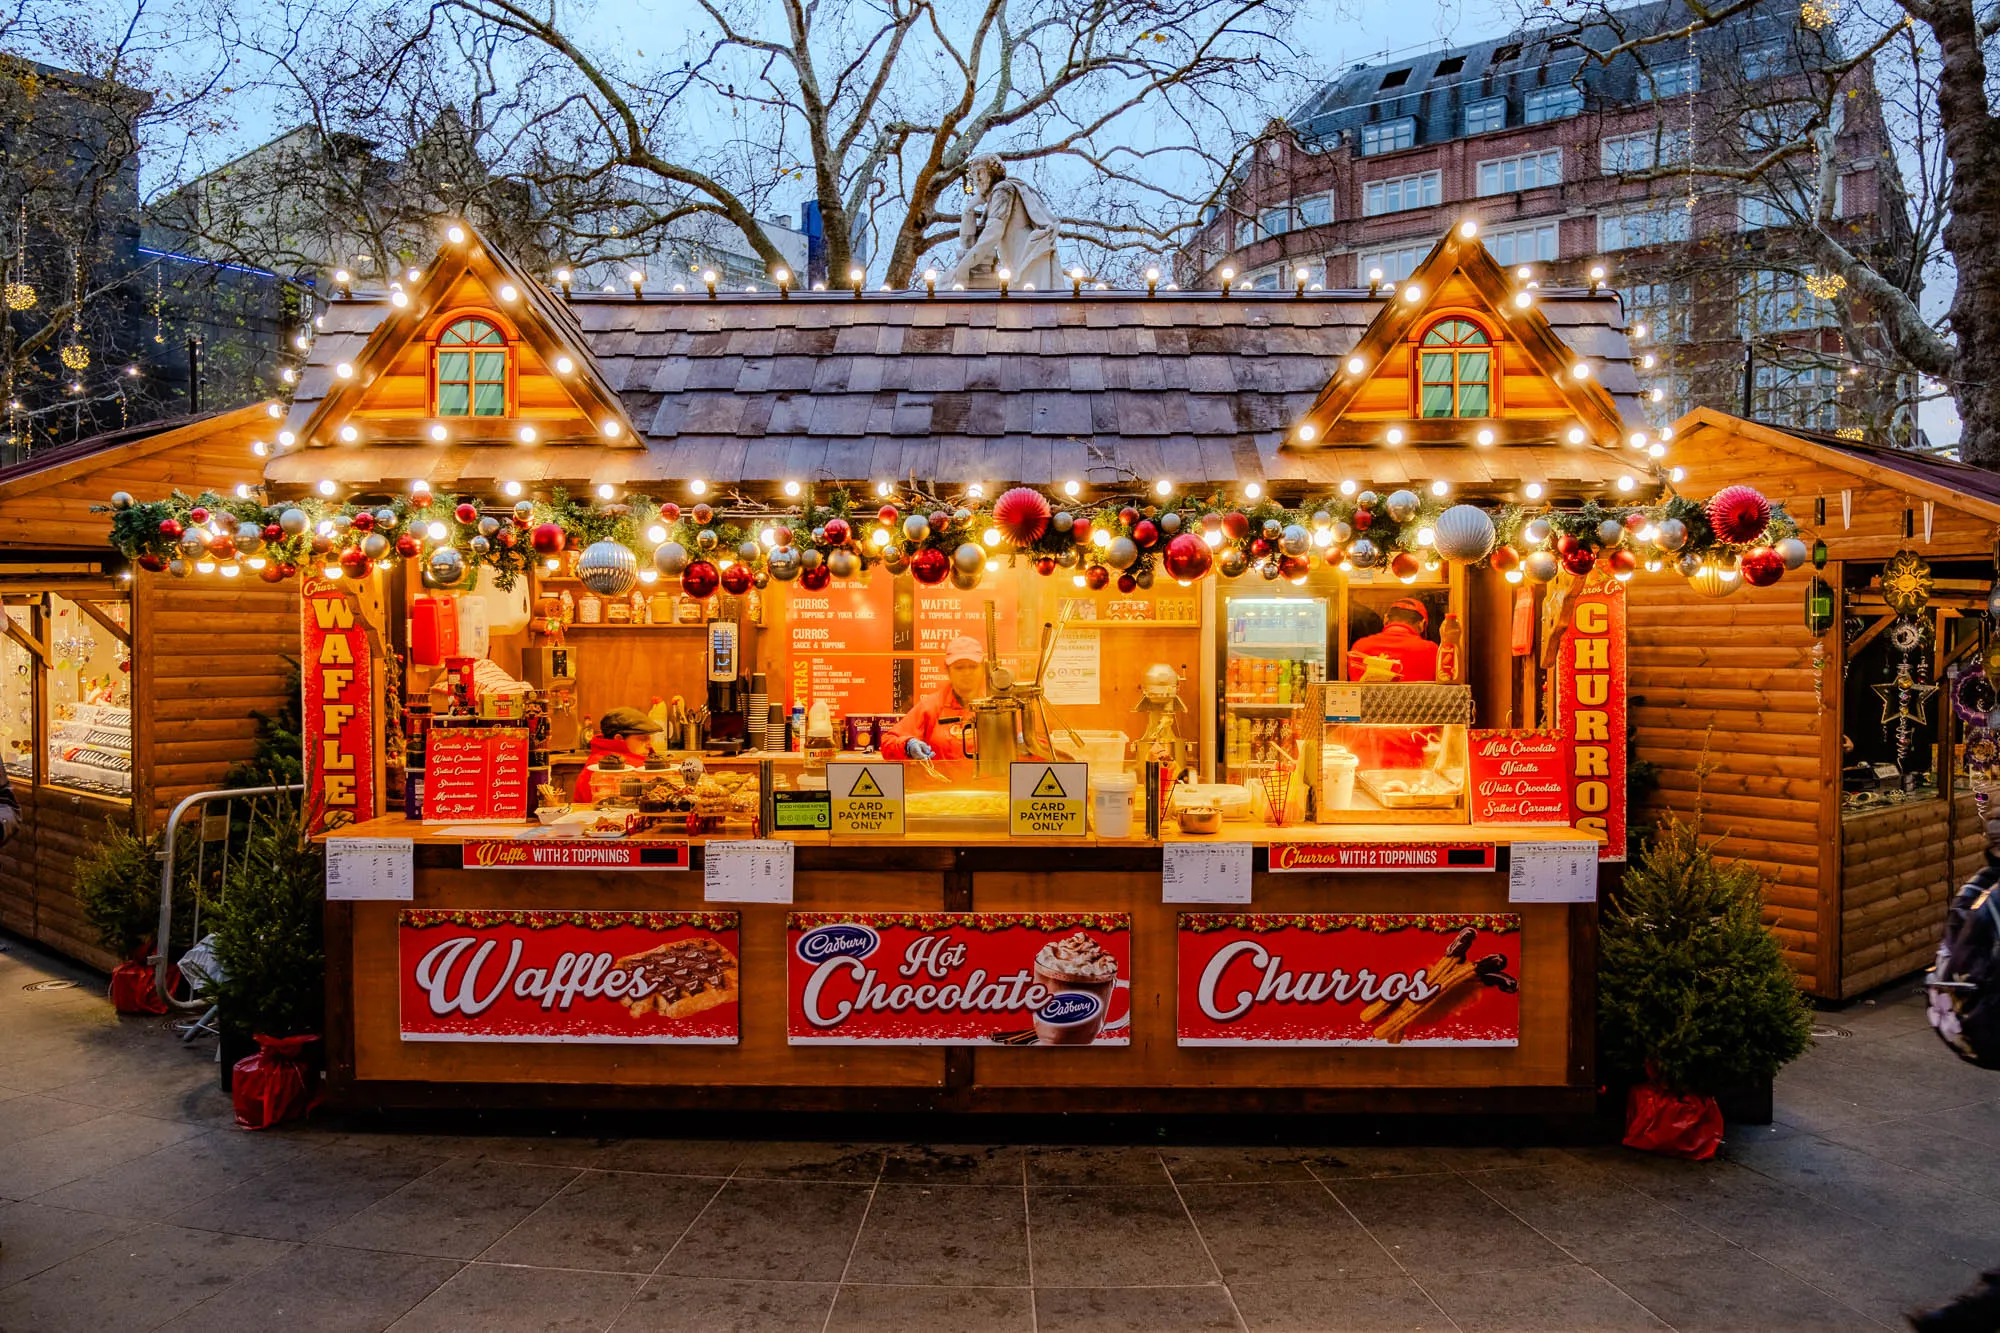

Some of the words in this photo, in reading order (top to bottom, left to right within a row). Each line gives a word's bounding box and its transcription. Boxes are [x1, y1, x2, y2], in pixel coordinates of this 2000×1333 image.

[793, 598, 829, 609] CURROS
[921, 599, 961, 609] WAFFLE
[801, 611, 826, 619] TOPPING
[793, 629, 829, 640] CURROS
[921, 629, 961, 640] WAFFLE
[1574, 603, 1610, 846] CHURROS
[1479, 741, 1508, 757] Milk
[1510, 741, 1556, 756] Chocolate
[1499, 761, 1539, 776] Nutella
[1479, 781, 1513, 796] White
[1515, 780, 1561, 796] Chocolate
[849, 802, 883, 810] CARD
[1031, 802, 1065, 811] CARD
[1483, 800, 1516, 817] Salted
[1519, 800, 1562, 816] Caramel
[839, 812, 894, 820] PAYMENT
[1020, 812, 1076, 821] PAYMENT
[851, 821, 882, 830] ONLY
[1032, 822, 1064, 831] ONLY
[476, 843, 528, 867] Waffle
[533, 848, 561, 863] WITH
[563, 848, 569, 863] 2
[571, 848, 630, 863] TOPPNINGS
[1280, 846, 1336, 870] Churros
[1339, 850, 1368, 865] WITH
[1369, 850, 1376, 865] 2
[1379, 850, 1437, 865] TOPPNINGS
[805, 932, 867, 956] Cadbury
[899, 936, 967, 977] Hot
[415, 937, 658, 1015] Waffles
[1199, 940, 1441, 1020] Churros
[802, 955, 1055, 1026] Chocolate
[1045, 997, 1096, 1017] Cadbury
